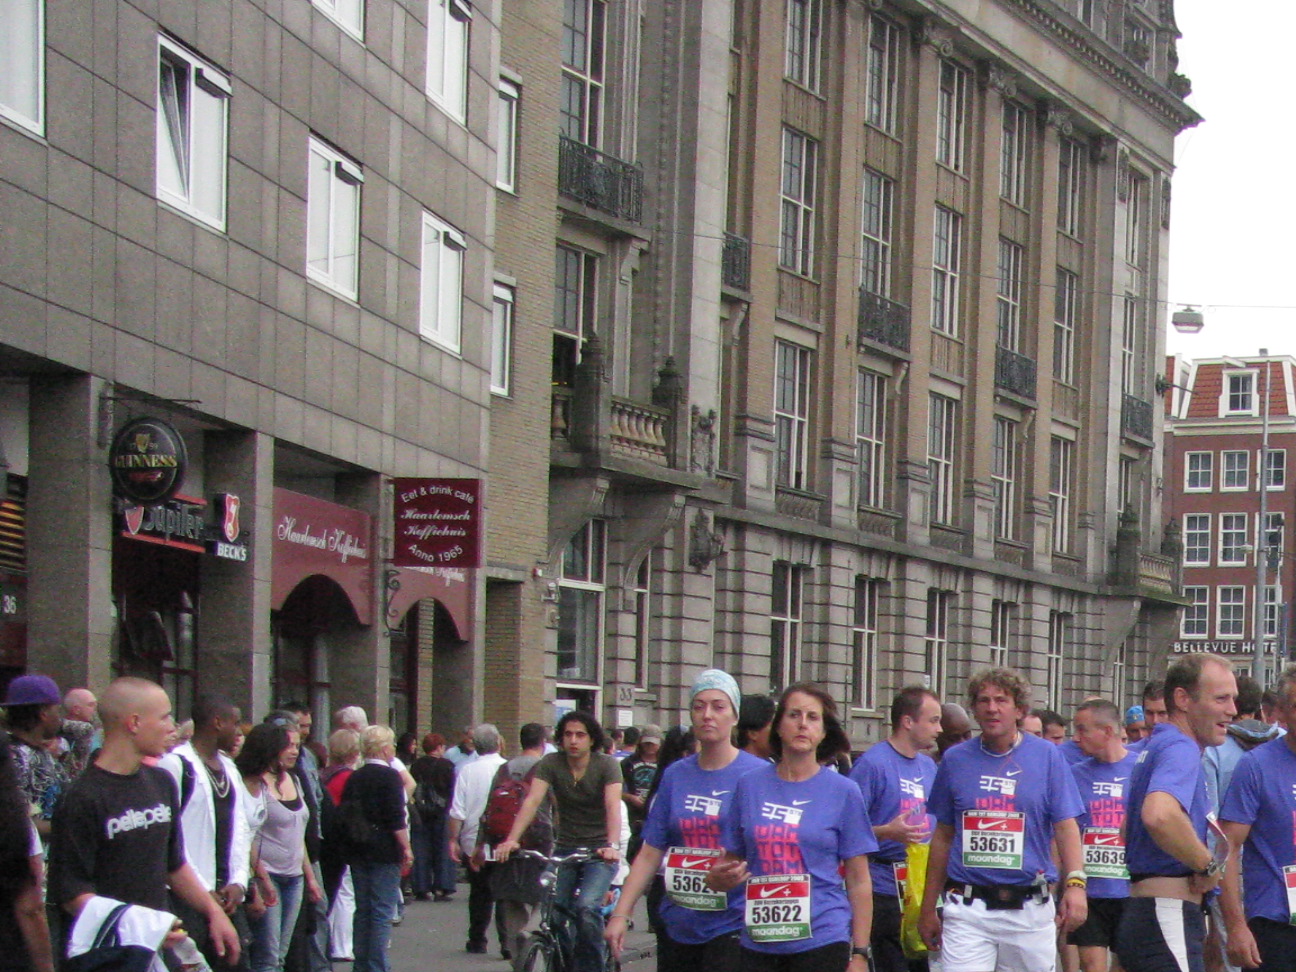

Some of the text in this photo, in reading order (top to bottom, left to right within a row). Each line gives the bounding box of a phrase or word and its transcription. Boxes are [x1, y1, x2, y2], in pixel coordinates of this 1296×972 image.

[114, 454, 178, 468] GUINNESS
[429, 485, 453, 496] drink
[217, 541, 248, 561] BECK'S
[408, 544, 464, 562] Anno 1965
[1173, 641, 1277, 654] BELLEVUE HTE
[969, 836, 1016, 853] 53631
[967, 854, 1013, 866] maandag
[1086, 850, 1126, 865] 53639
[673, 875, 718, 895] 5362
[752, 905, 802, 924] 53622
[751, 925, 801, 937] maandag
